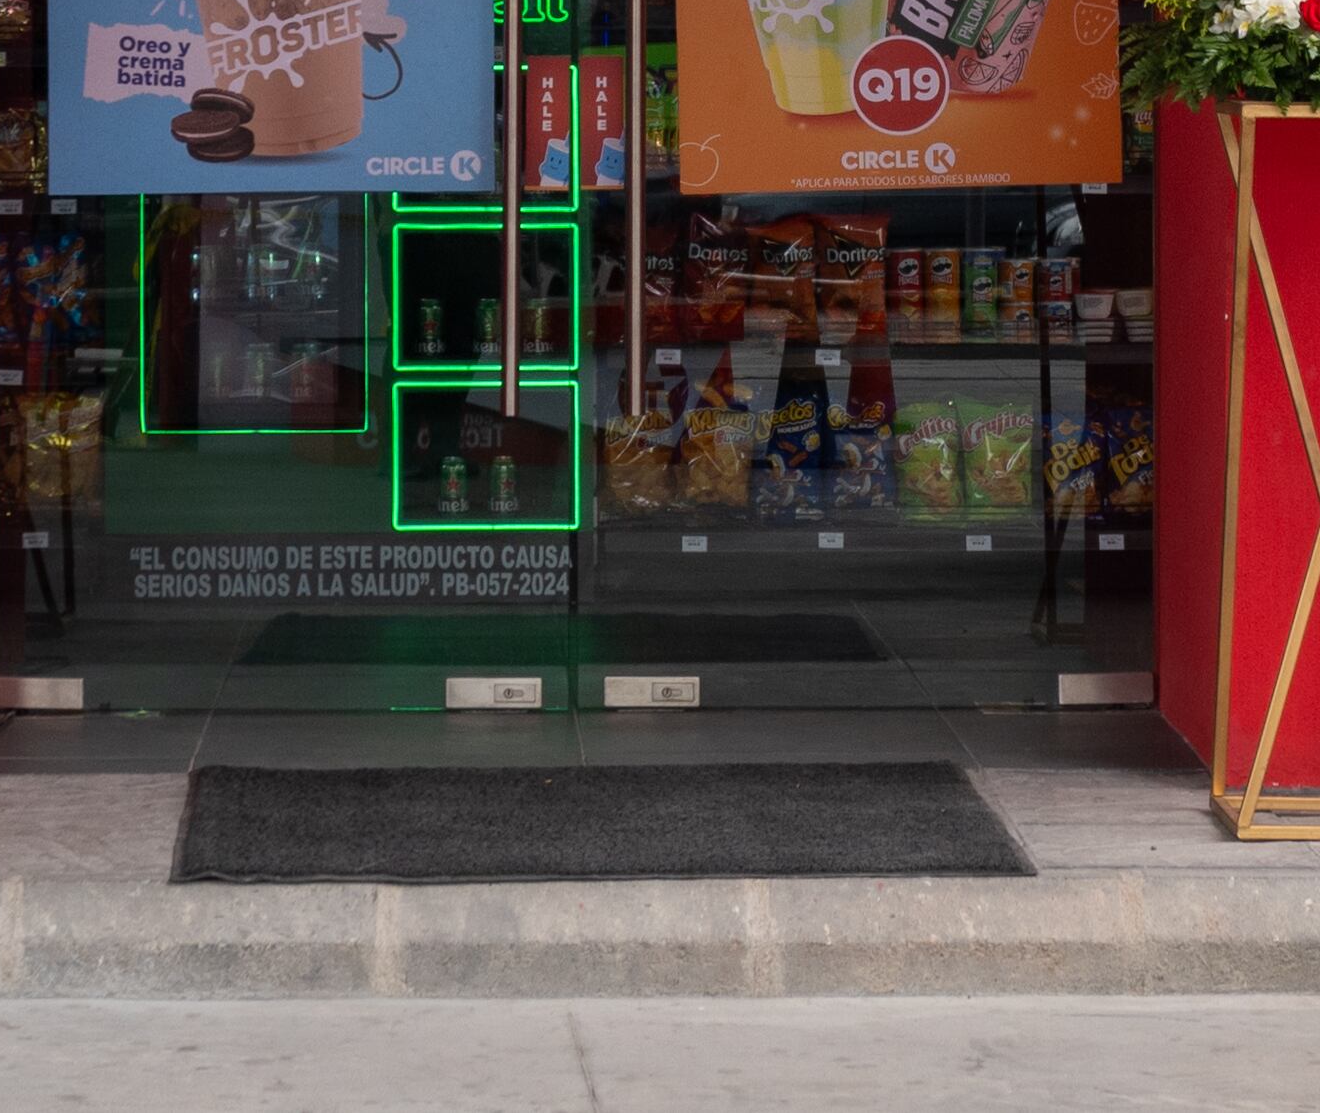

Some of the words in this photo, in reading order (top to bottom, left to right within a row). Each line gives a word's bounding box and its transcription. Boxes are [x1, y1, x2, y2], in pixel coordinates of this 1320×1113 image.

[119, 36, 173, 55] Oreo
[177, 40, 190, 57] y
[118, 56, 185, 72] crema
[117, 68, 186, 87] batida
[859, 68, 940, 104] Q19
[541, 77, 554, 131] HALE
[595, 76, 608, 131] HALE
[366, 157, 445, 176] CIRCLE
[450, 149, 481, 182] K
[841, 150, 919, 170] CIRCLE
[924, 142, 956, 174] K
[833, 176, 859, 187] PARA
[861, 175, 895, 186] TODOS
[897, 175, 916, 185] LOS
[919, 173, 963, 184] SABORES
[966, 173, 1010, 184] BAMBOO
[688, 242, 749, 262] Doritos
[762, 246, 813, 263] Doritos
[826, 246, 886, 264] Doritos
[171, 545, 279, 570] CONSUMO
[286, 545, 312, 570] DE
[319, 545, 373, 570] ESTE
[379, 545, 494, 570] PRODUCTO
[503, 545, 572, 569] CAUSA
[134, 573, 211, 598] SERIOS
[218, 568, 290, 598] DAÑOS
[296, 573, 312, 597] A
[318, 573, 343, 597] LA
[442, 572, 569, 596] PB-057-2024
